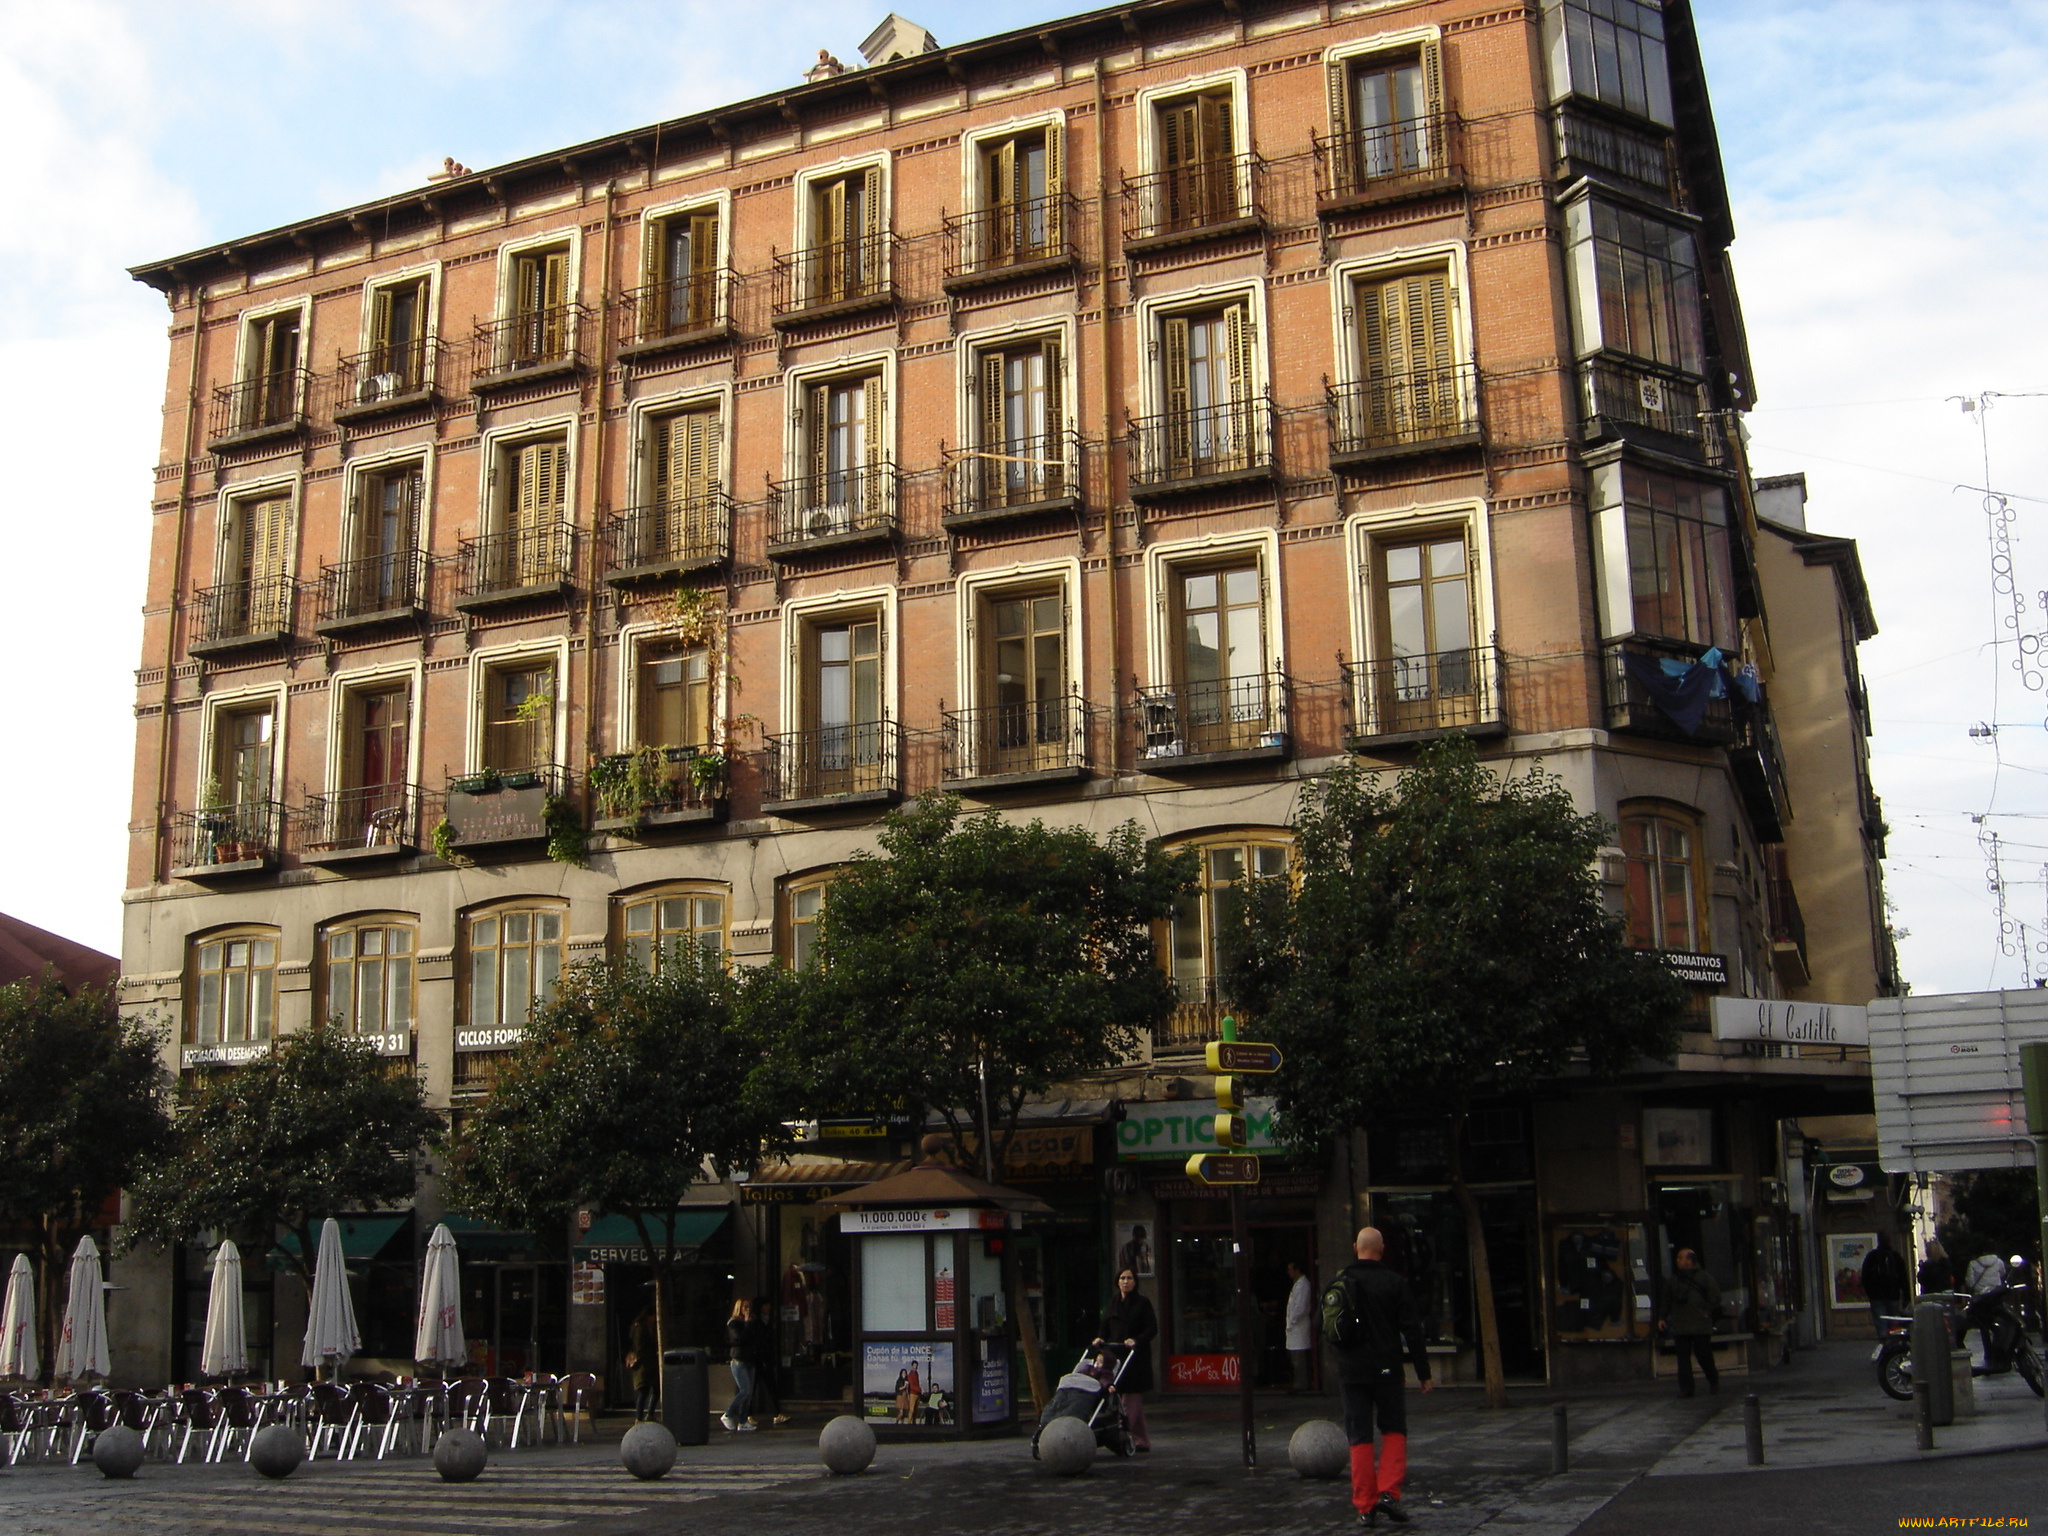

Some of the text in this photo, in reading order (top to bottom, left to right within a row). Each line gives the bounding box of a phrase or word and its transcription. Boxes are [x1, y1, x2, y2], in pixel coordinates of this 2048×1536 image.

[1671, 969, 1726, 982] FORMÁTICA
[1758, 1003, 1838, 1041] El Castillo
[388, 1033, 403, 1051] 31
[458, 1028, 524, 1046] CICLOS FORM
[184, 1045, 226, 1063] FORMACIÓN
[875, 1113, 910, 1125] Btique
[743, 1186, 832, 1201] Tallas 40
[590, 1248, 682, 1262] CERVECRA
[866, 1345, 932, 1356] Cupón de la ONCE
[866, 1354, 889, 1362] Ganas
[1207, 1370, 1220, 1380] SOL
